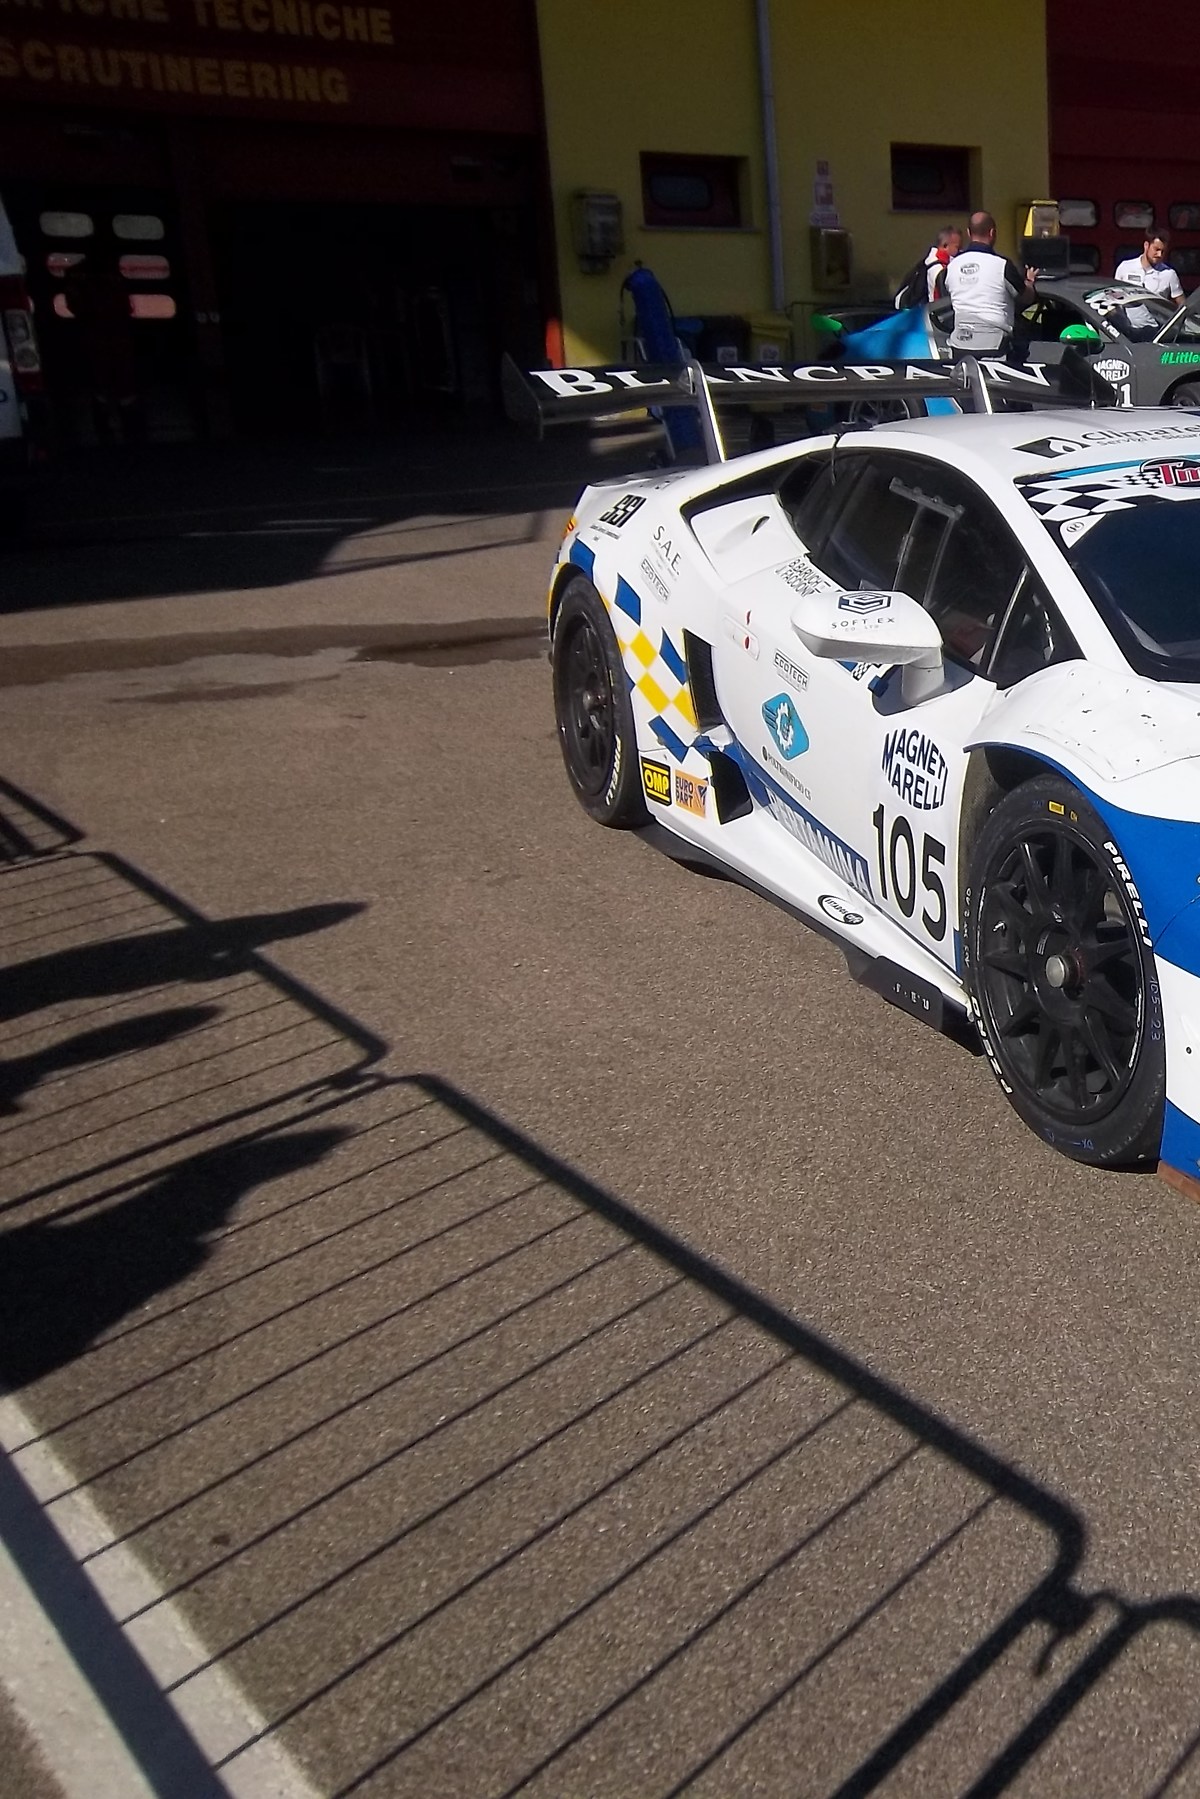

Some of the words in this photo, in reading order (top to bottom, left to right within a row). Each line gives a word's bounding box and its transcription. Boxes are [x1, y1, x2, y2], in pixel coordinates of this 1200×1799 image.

[194, 0, 395, 46] TECNICHE
[0, 36, 349, 105] SCRUTINEERING
[529, 361, 1052, 399] BLNCPAN
[653, 525, 683, 576] S.A.E.
[774, 651, 808, 689] ECOTECH
[882, 728, 948, 780] MAGNETI
[644, 769, 670, 795] OMP
[676, 775, 694, 794] EURO
[676, 789, 694, 808] PART
[882, 758, 948, 811] MARELLI
[872, 803, 947, 942] 105
[1103, 841, 1153, 948] PIRELLI
